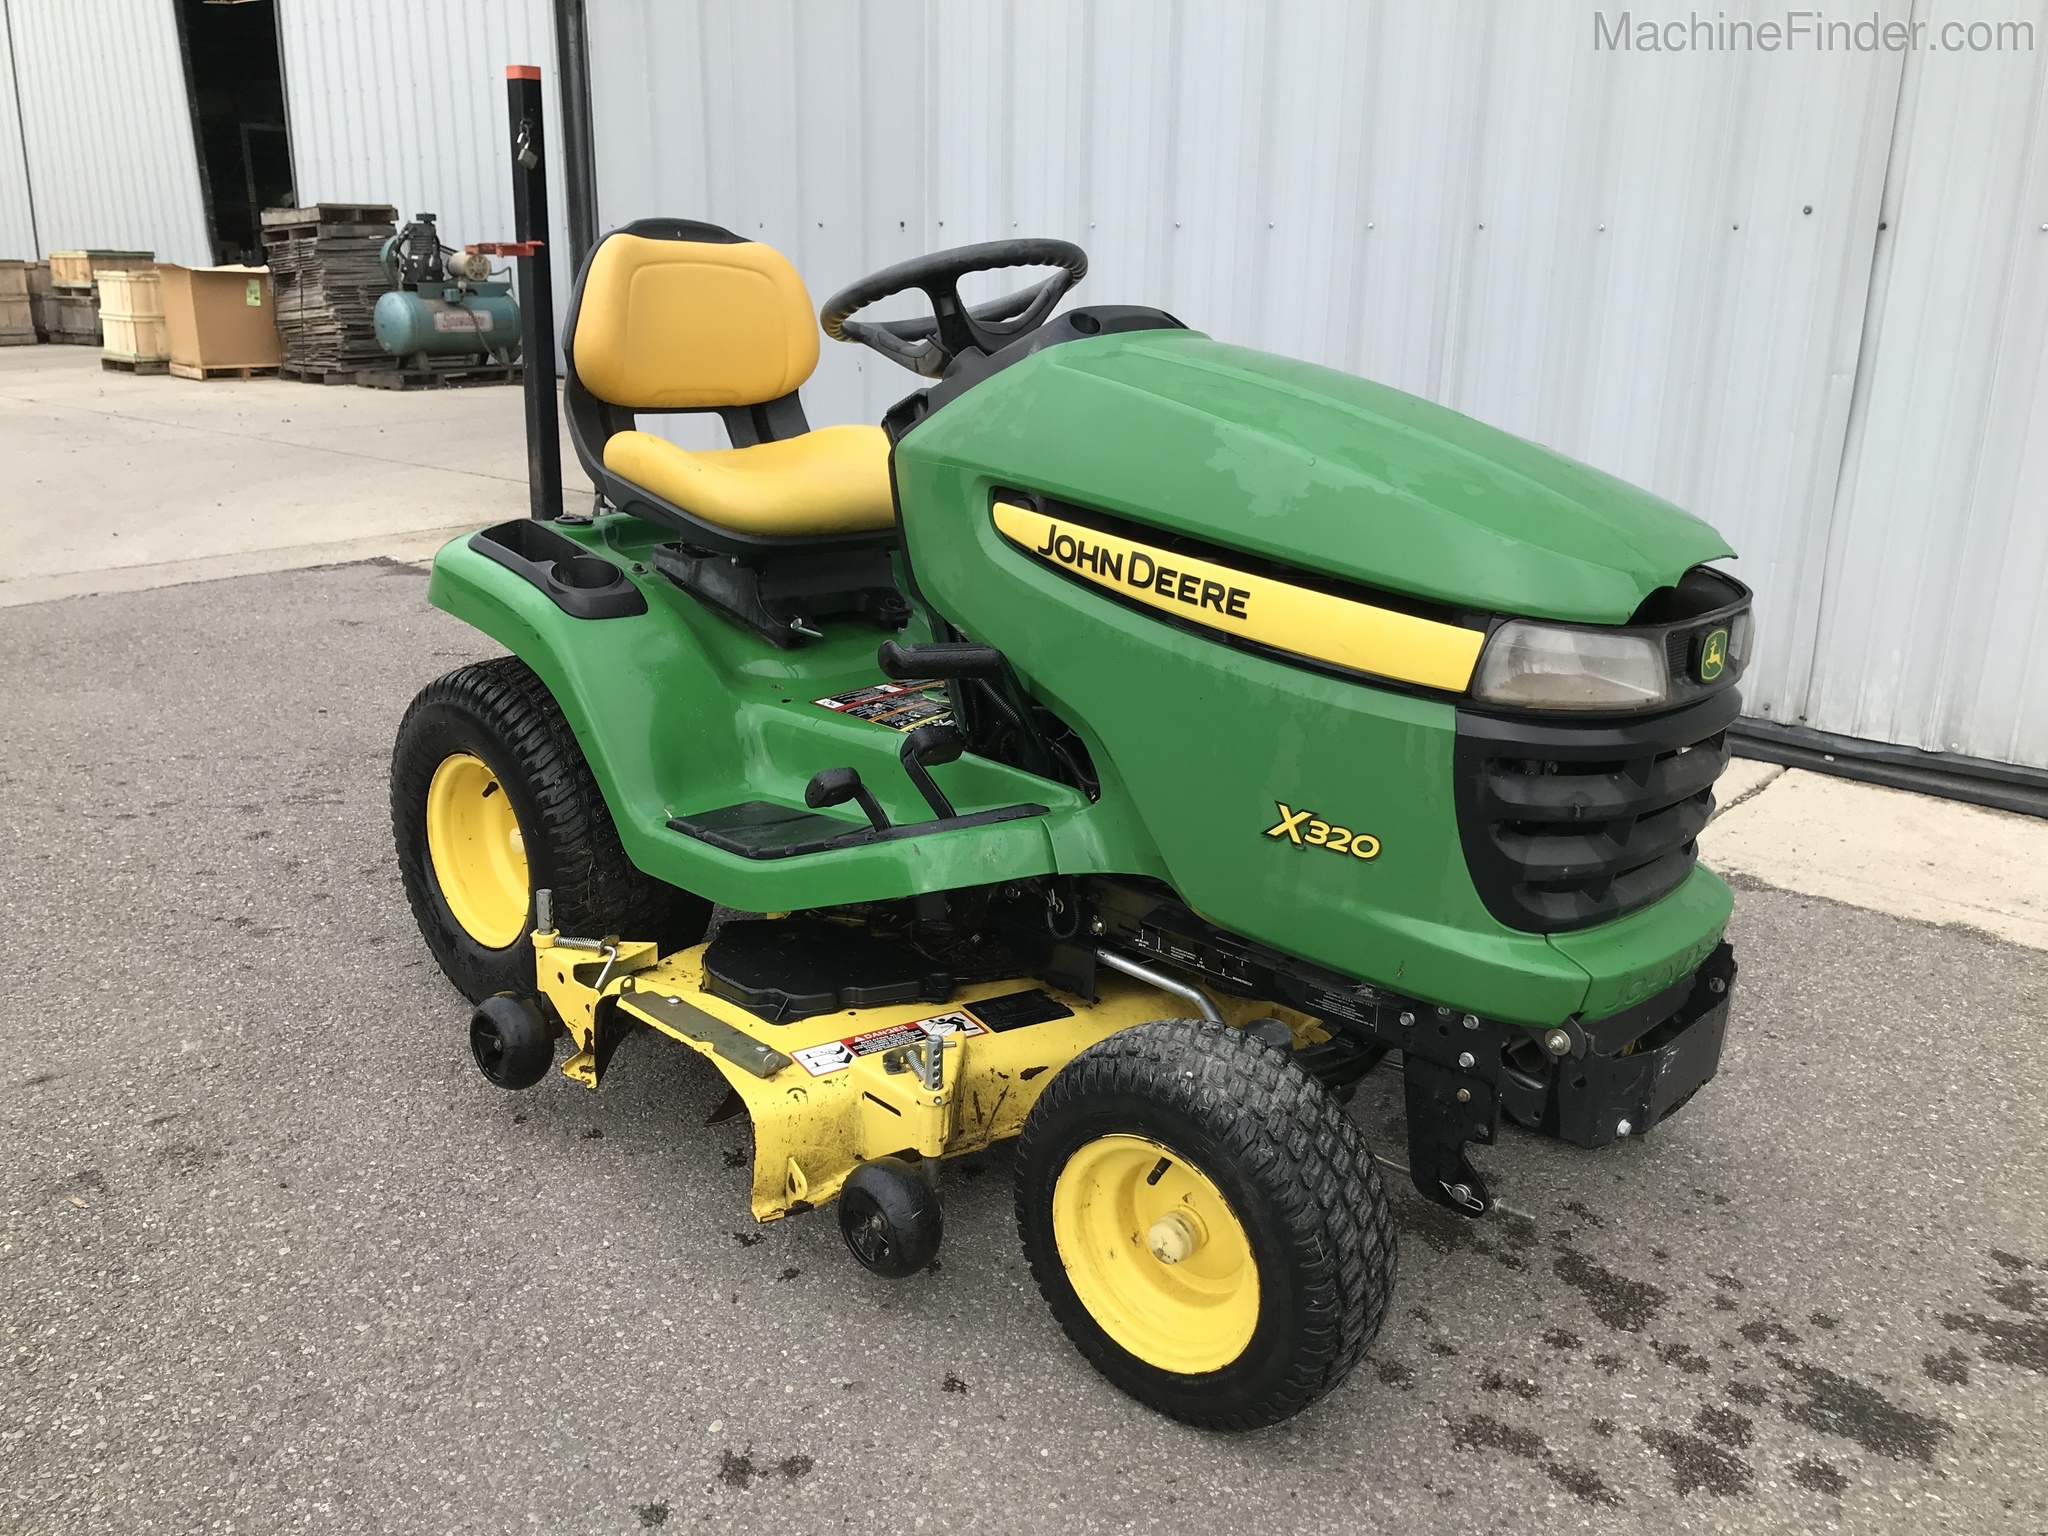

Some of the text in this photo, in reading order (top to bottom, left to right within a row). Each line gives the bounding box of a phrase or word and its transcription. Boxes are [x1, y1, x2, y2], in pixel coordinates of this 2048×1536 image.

[442, 312, 485, 331] Speedare
[1038, 524, 1250, 619] JOHN DEERE
[1260, 800, 1382, 860] X320
[863, 1024, 909, 1039] DANGER
